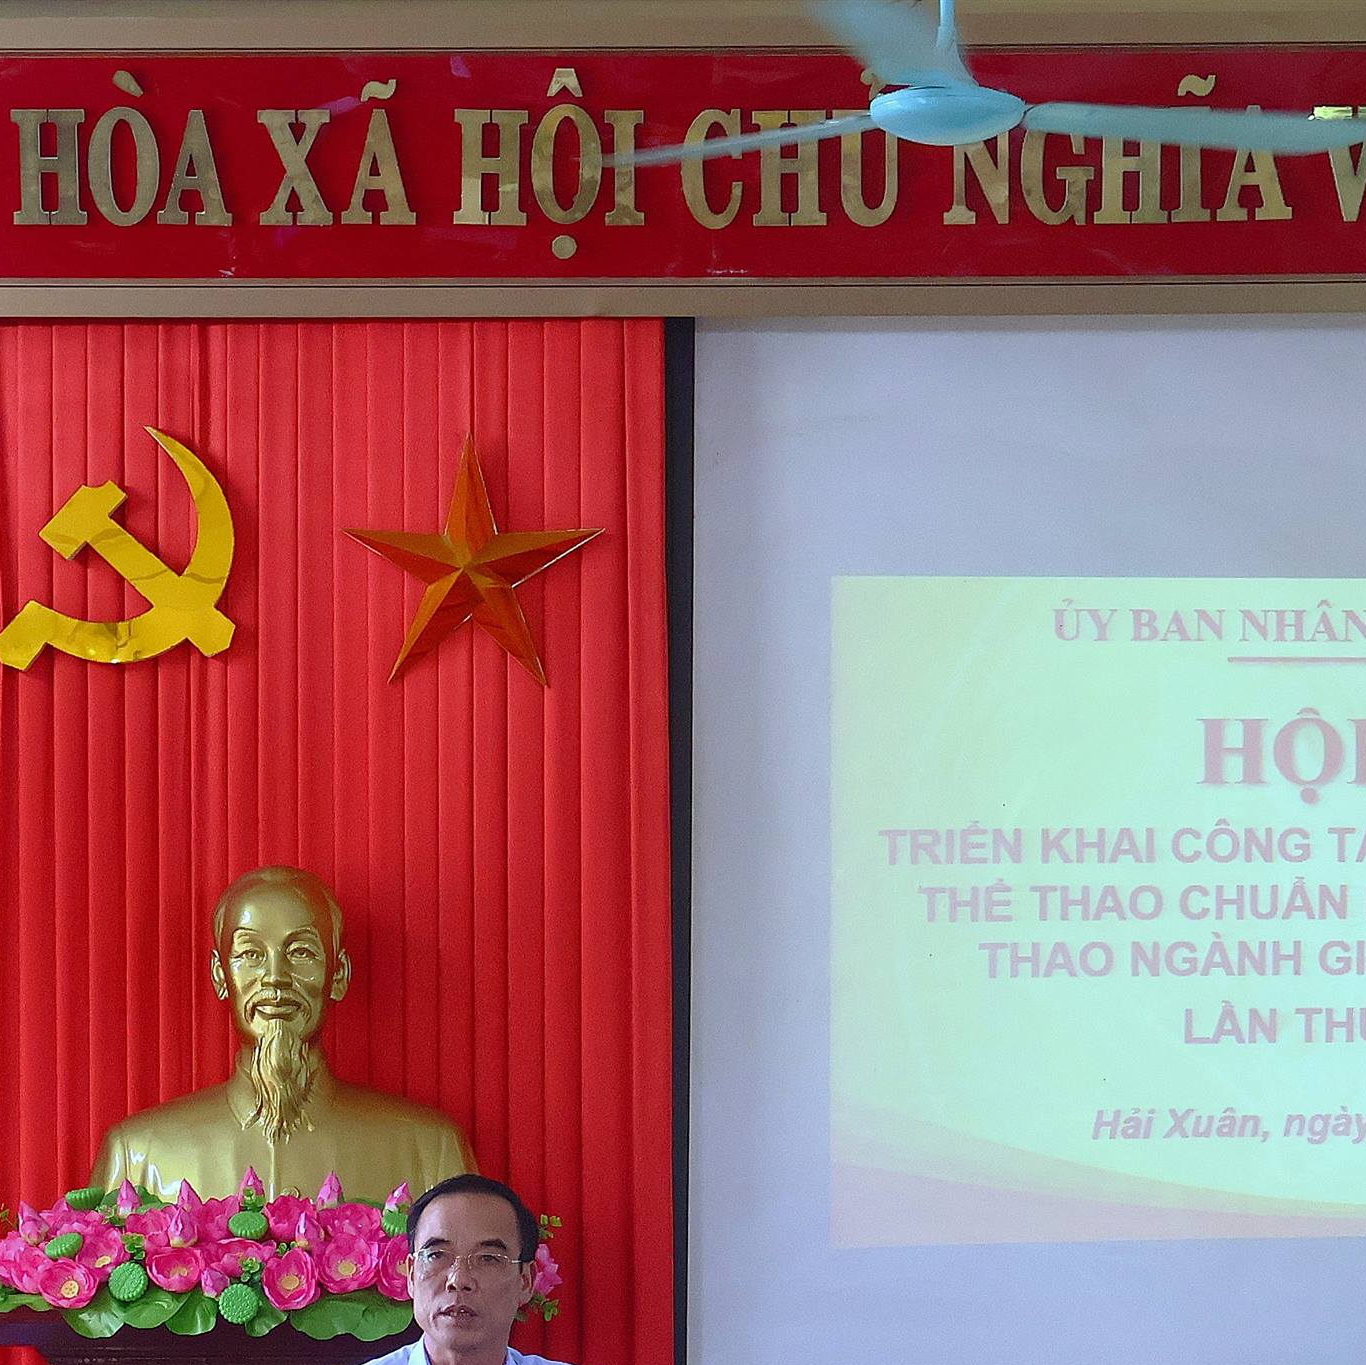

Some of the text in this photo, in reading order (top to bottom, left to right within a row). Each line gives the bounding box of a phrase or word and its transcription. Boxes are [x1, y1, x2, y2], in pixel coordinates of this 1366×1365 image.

[9, 69, 233, 228] HÒA
[257, 77, 417, 228] XÃ
[453, 67, 647, 260] HỘI
[1130, 608, 1226, 643] BAN
[878, 820, 1024, 866] TRIỂN
[1040, 827, 1157, 865] KHAI
[1170, 818, 1313, 865] CÔNG
[1029, 884, 1164, 922] THAO
[1178, 876, 1350, 922] CHUẨN
[979, 941, 1114, 980] THAO
[1130, 932, 1303, 978] NGÀNH
[1183, 1000, 1279, 1045] LẦN
[1091, 1107, 1156, 1142] Hải
[1163, 1108, 1272, 1144] Xuân,
